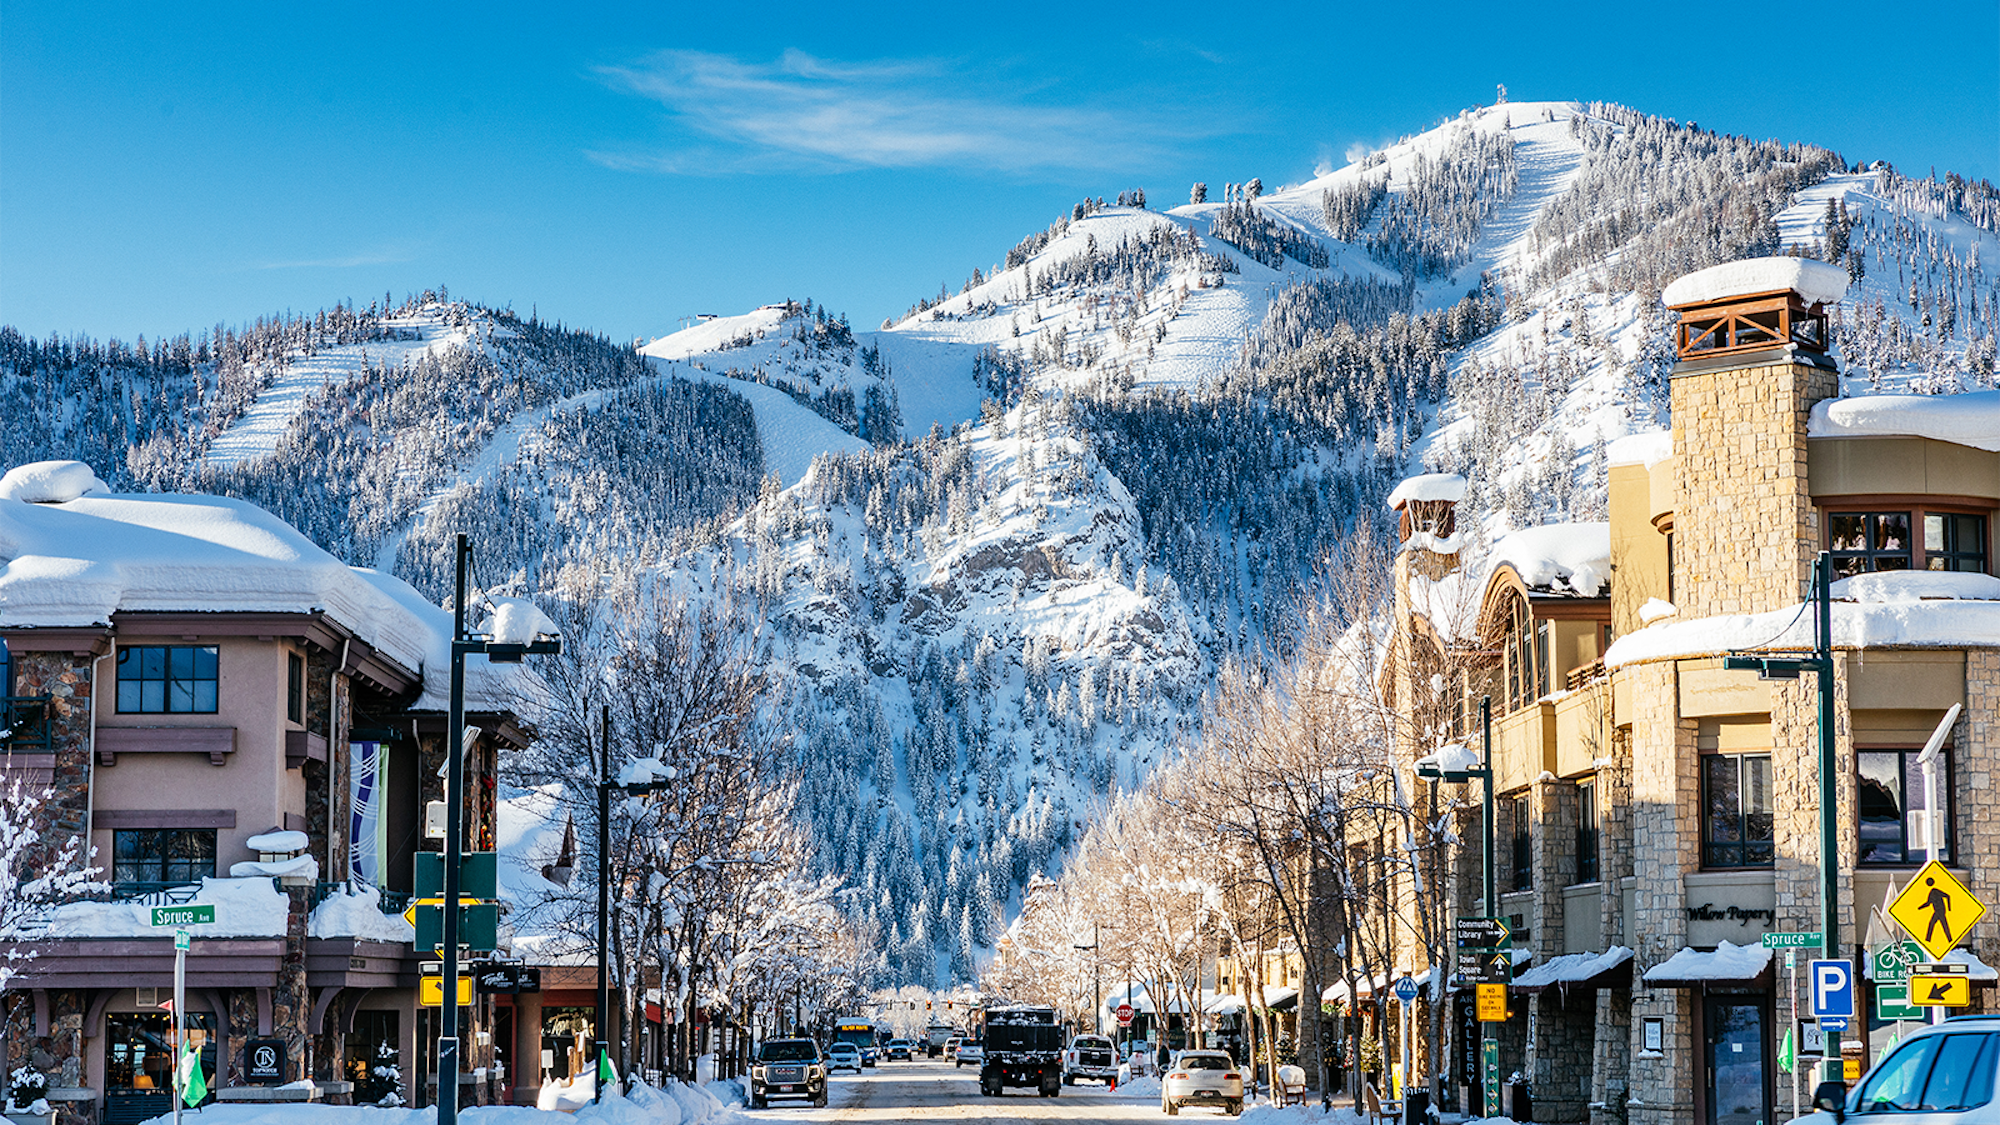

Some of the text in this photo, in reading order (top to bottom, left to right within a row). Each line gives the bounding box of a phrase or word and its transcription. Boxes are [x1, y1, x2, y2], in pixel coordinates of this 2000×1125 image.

[156, 909, 194, 925] Spruce
[1687, 903, 1775, 927] Willow Papery
[1457, 919, 1495, 929] Community
[1457, 930, 1482, 940] Library
[1764, 933, 1805, 947] Spruce
[1458, 955, 1476, 964] Town
[1458, 965, 1482, 975] Square
[1877, 970, 1895, 979] BIKE
[1817, 966, 1847, 1010] P
[1117, 1009, 1134, 1018] STOP
[1464, 1006, 1475, 1084] GALLERY
